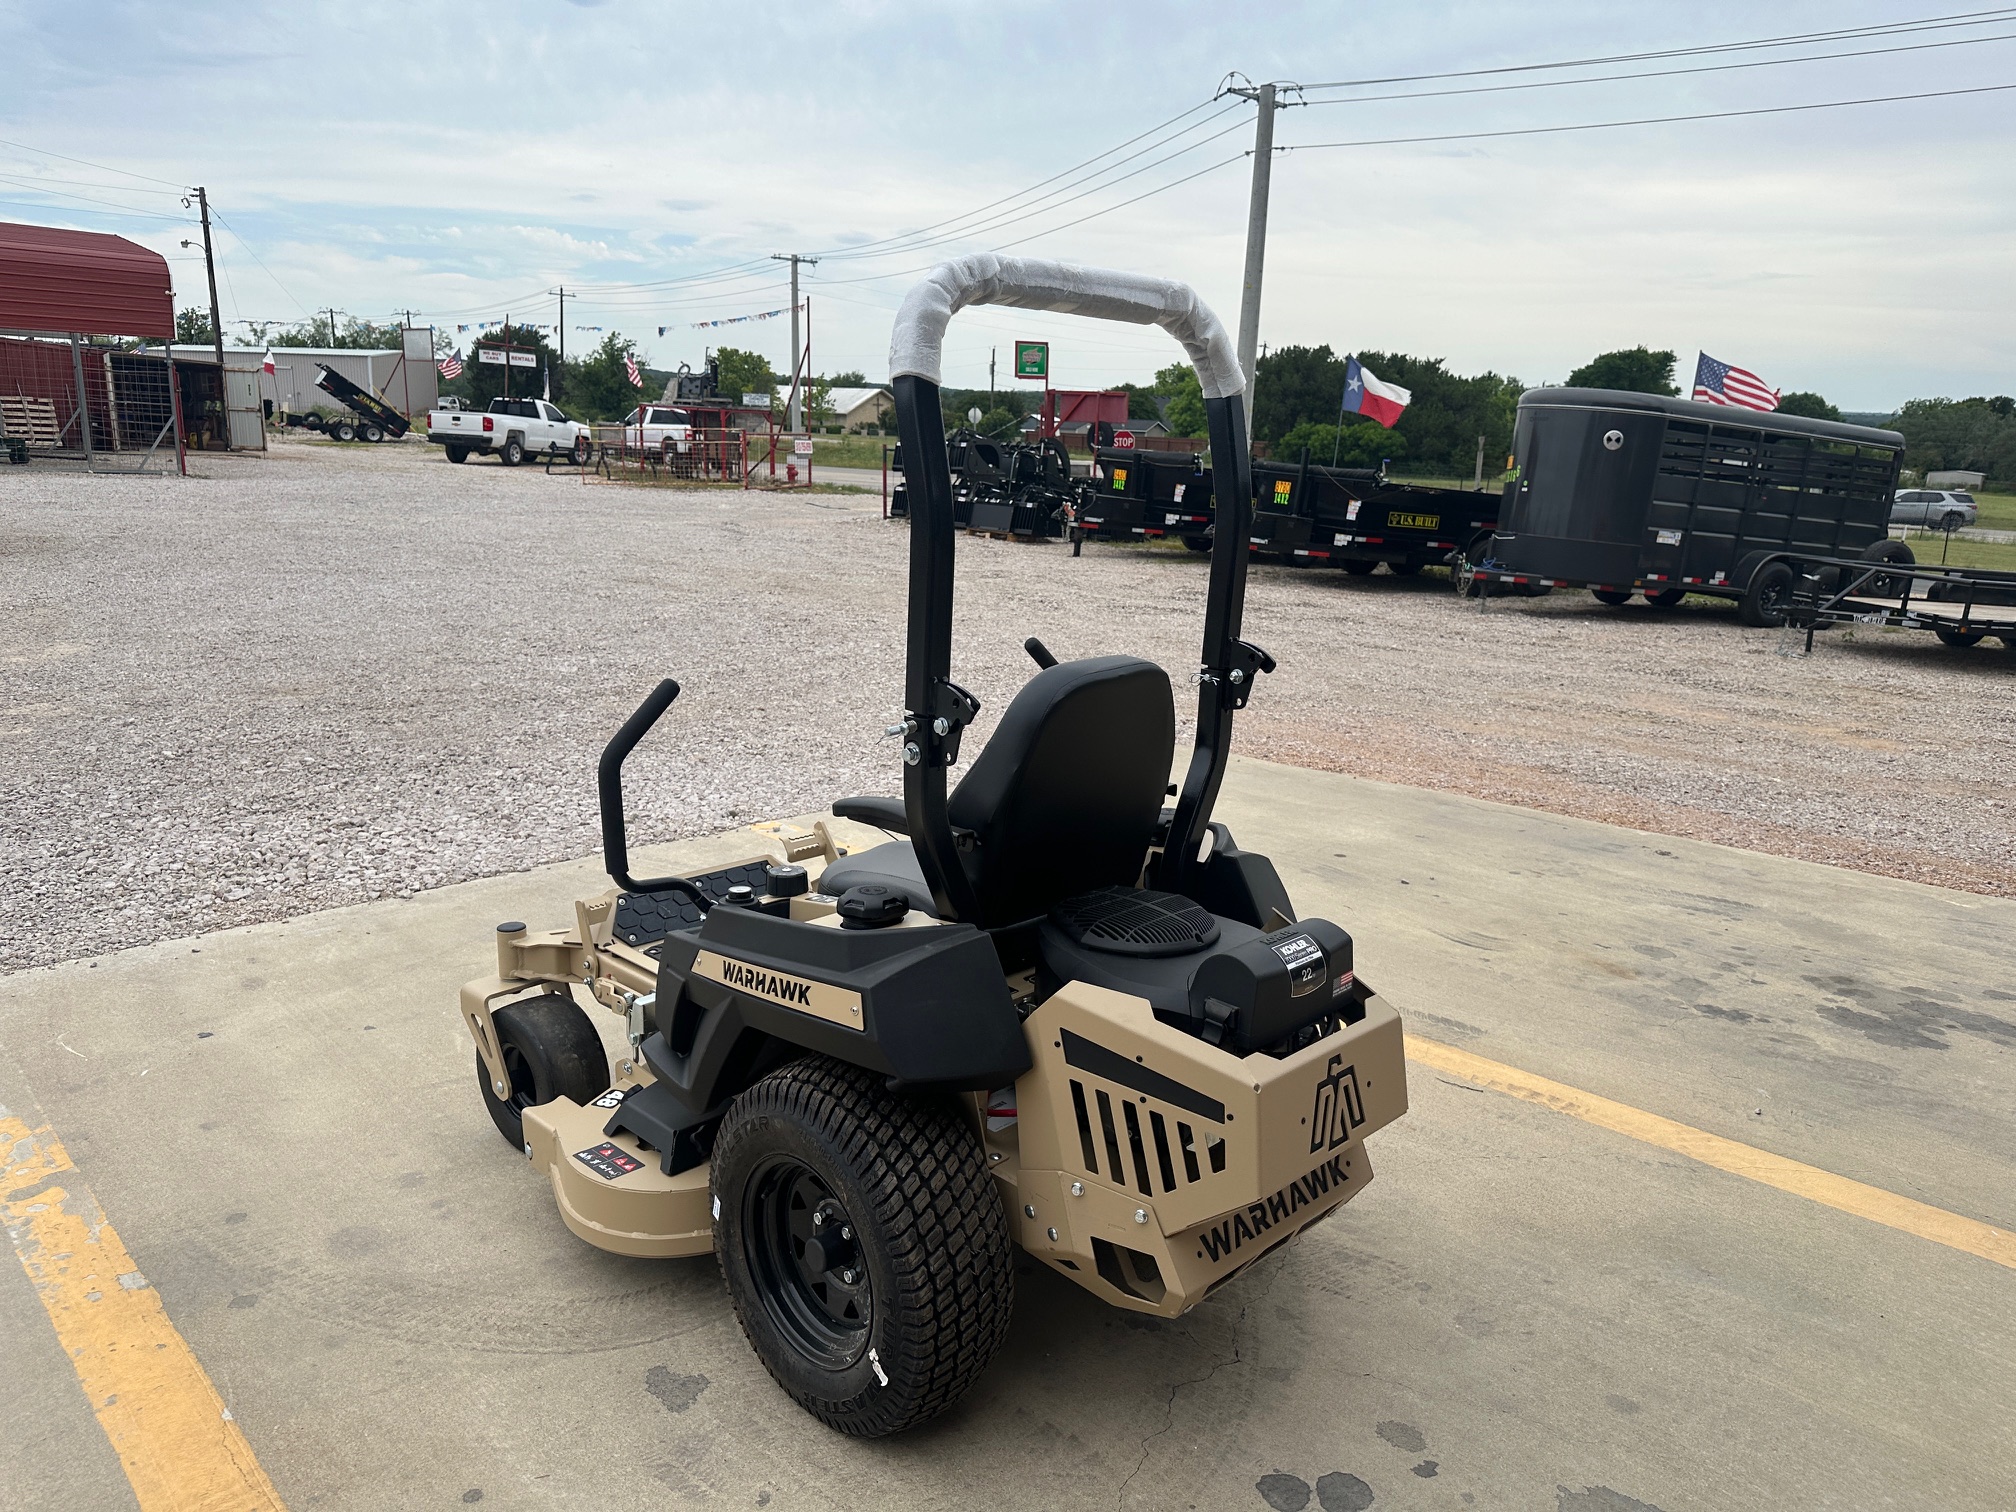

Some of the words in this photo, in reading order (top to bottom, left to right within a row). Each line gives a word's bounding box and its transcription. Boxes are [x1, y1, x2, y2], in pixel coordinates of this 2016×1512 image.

[1113, 437, 1134, 448] STOP
[1400, 514, 1414, 526] U.S.
[1415, 516, 1438, 528] BUILT
[1279, 940, 1310, 956] KOHLER
[1306, 945, 1318, 955] PRO
[1301, 967, 1313, 982] 22
[723, 960, 812, 1007] WARHAWK
[1199, 1154, 1350, 1263] WARHAWK
